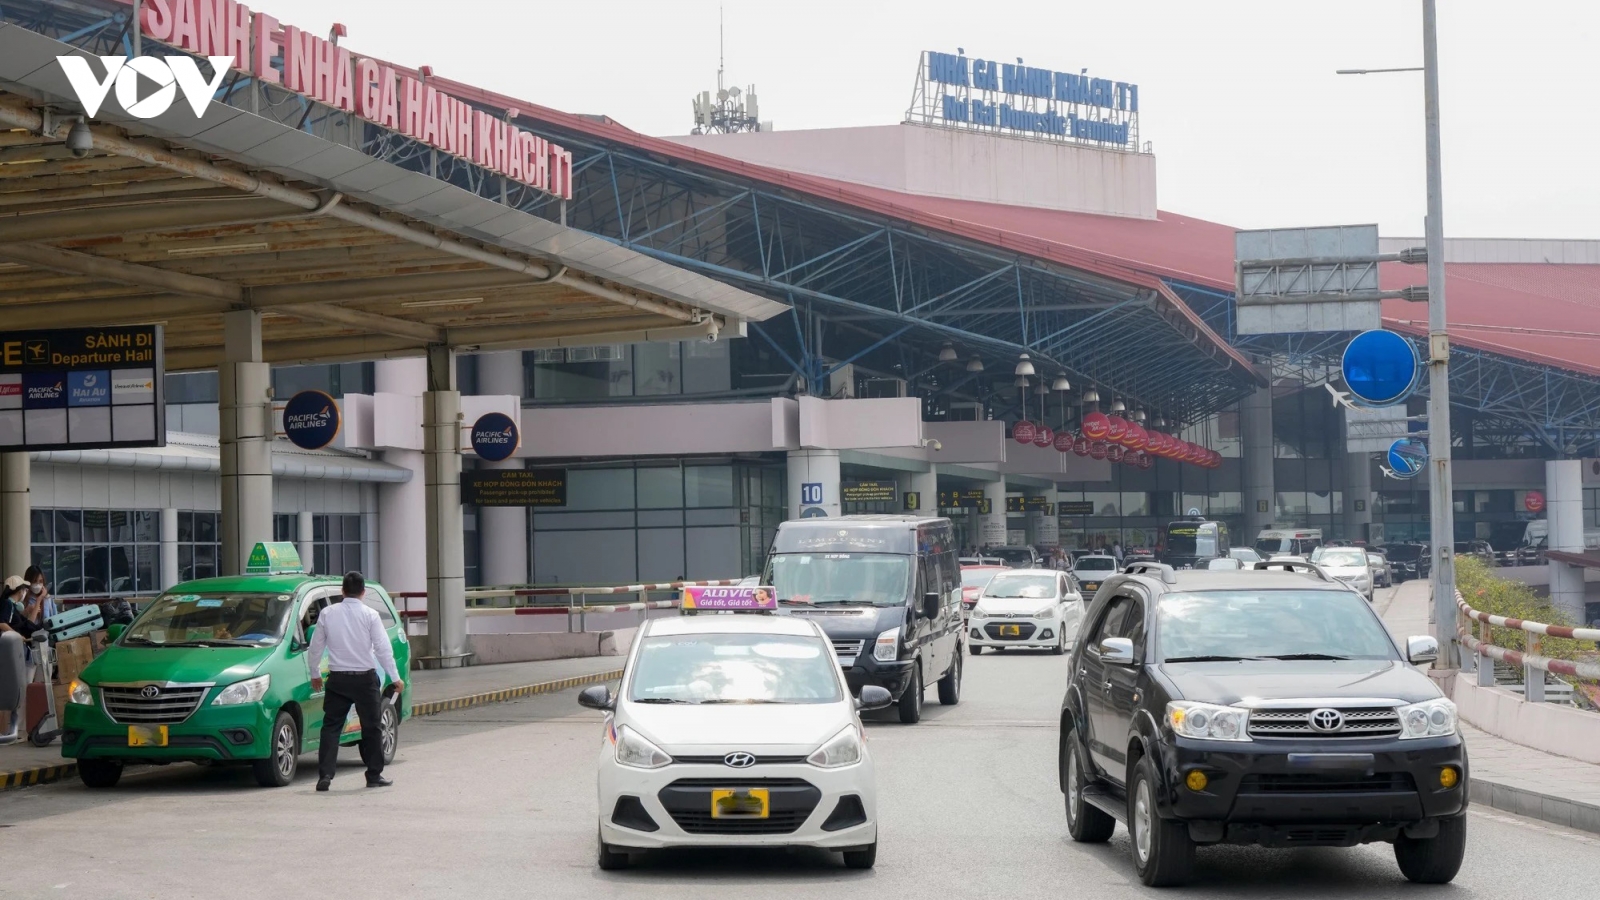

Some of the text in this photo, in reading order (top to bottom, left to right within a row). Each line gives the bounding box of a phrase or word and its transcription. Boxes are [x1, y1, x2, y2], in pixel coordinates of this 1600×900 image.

[973, 58, 998, 91] GA
[1055, 68, 1113, 108] KHÁCH
[1116, 82, 1138, 112] T1
[255, 13, 279, 83] E
[356, 58, 398, 130] GA
[473, 107, 548, 190] KHÁCH
[548, 143, 572, 199] T1
[1000, 103, 1066, 135] Domestic
[1069, 113, 1128, 144] Terminal
[136, 333, 152, 346] ĐI
[4, 341, 23, 365] E
[52, 349, 152, 366] Departure Hall
[288, 412, 318, 423] PACIFIC
[289, 420, 326, 430] AIRLINES
[804, 486, 820, 502] 10
[908, 493, 917, 508] 9
[1046, 504, 1053, 515] 7
